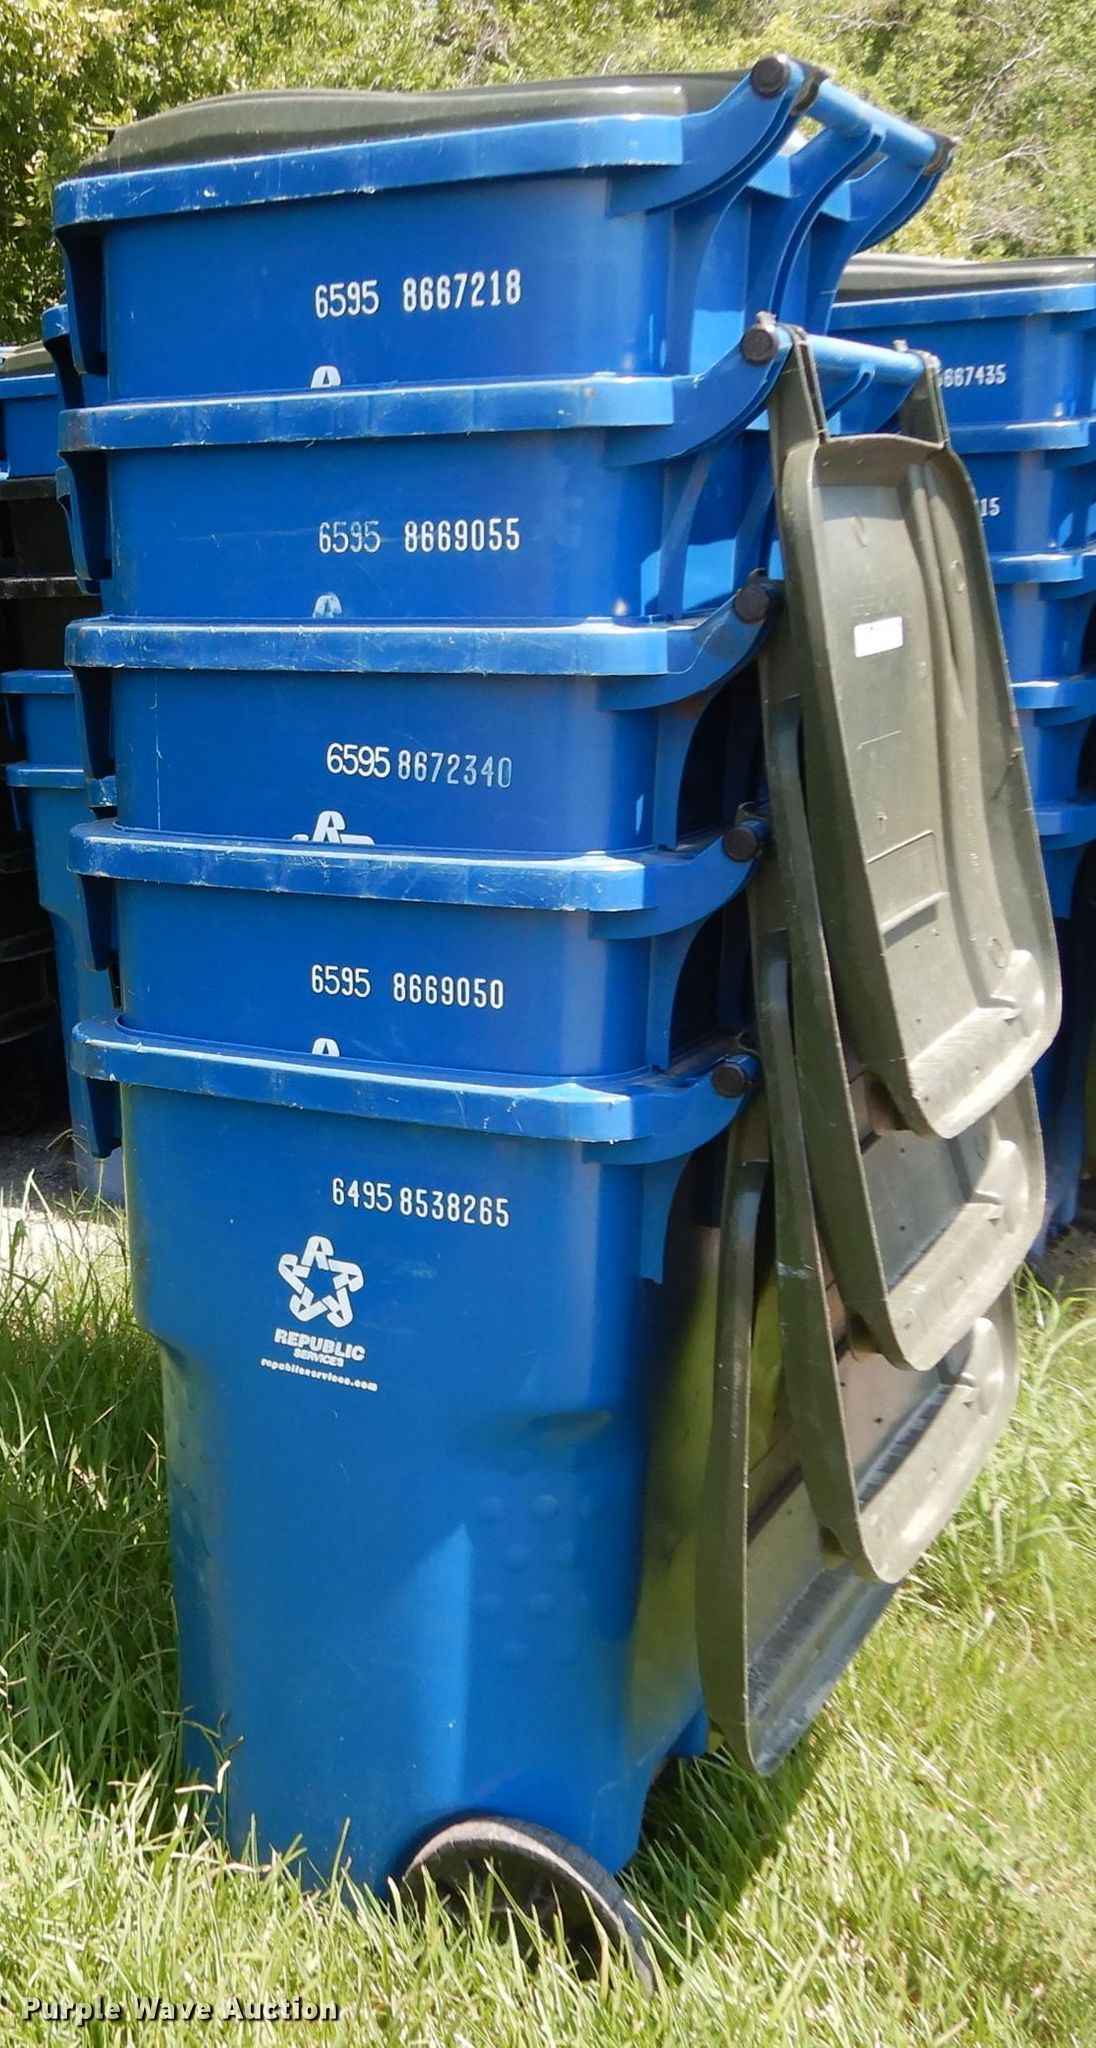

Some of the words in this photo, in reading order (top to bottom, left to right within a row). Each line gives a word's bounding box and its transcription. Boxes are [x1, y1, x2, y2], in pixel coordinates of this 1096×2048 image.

[315, 279, 380, 318] 6595
[403, 269, 521, 312] 8667218
[319, 521, 381, 553] 6595
[404, 518, 520, 552] 8669055
[327, 743, 390, 778] 6595
[398, 750, 512, 788] 8672340
[312, 964, 370, 998] 6595
[393, 973, 503, 1009] 8669050
[332, 1178, 393, 1212] 6495
[400, 1187, 509, 1227] 8538265
[274, 1328, 366, 1361] REPUBLIC
[293, 1348, 344, 1367] SERVICES
